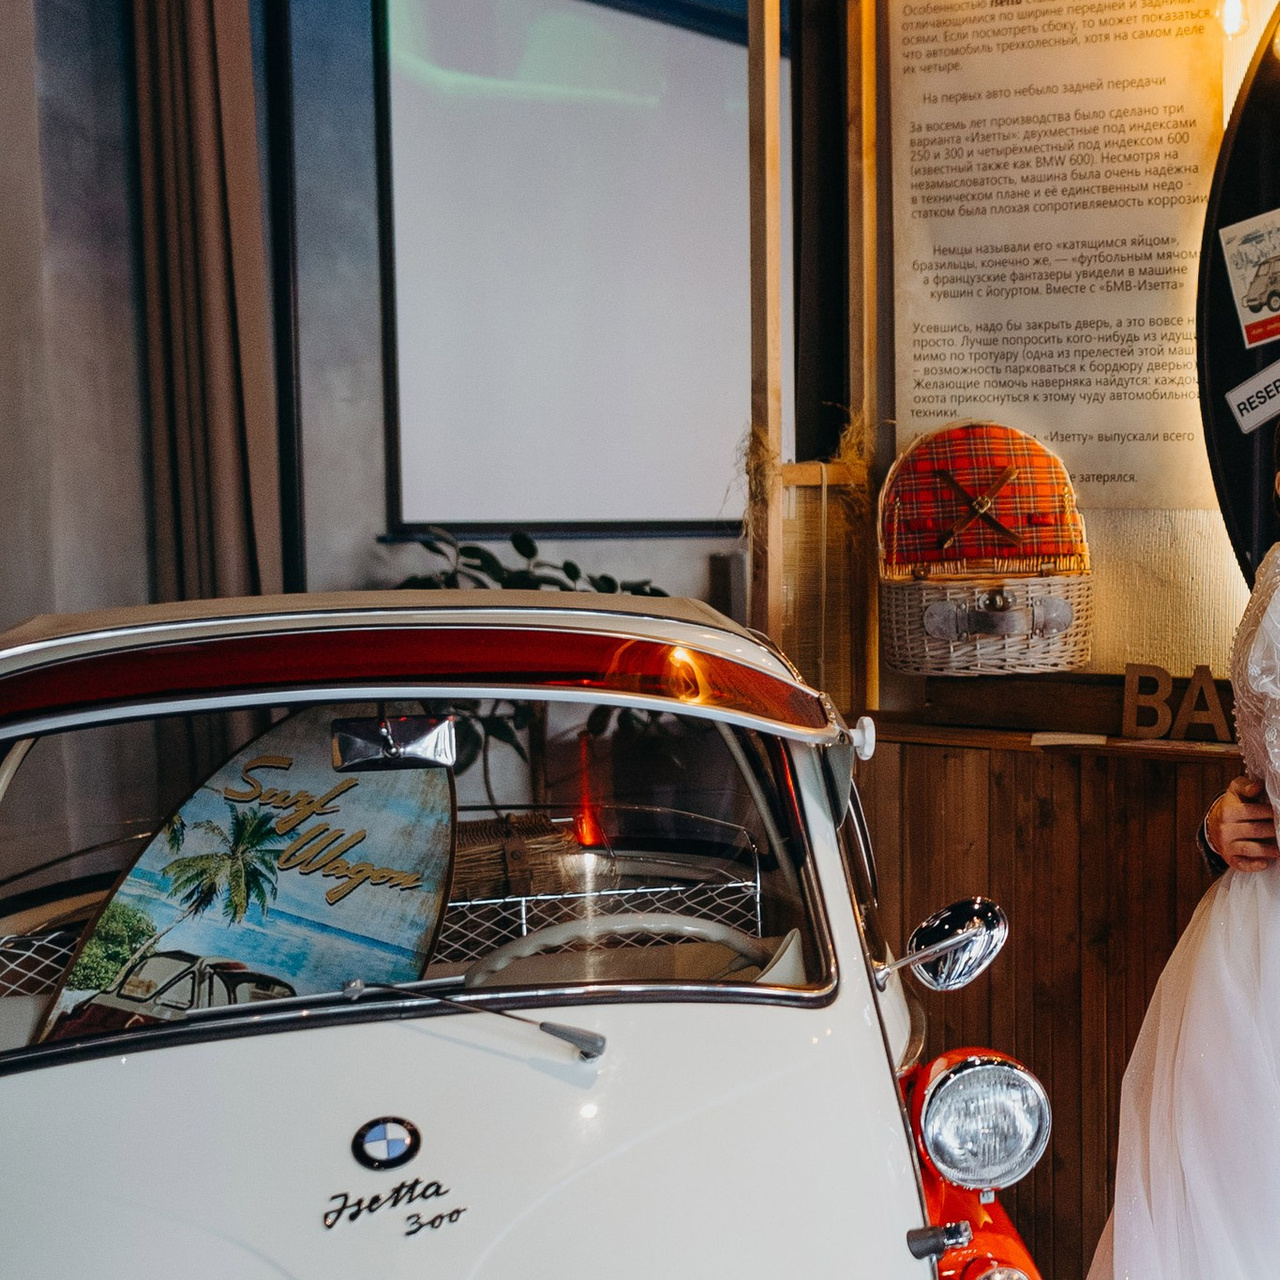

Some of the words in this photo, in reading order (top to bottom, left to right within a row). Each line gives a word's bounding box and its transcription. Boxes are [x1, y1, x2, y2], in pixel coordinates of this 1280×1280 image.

[1016, 6, 1064, 20] ширине
[942, 29, 969, 40] Если
[970, 24, 1039, 37] посмотреть
[1097, 14, 1137, 26] может
[902, 49, 922, 59] что
[924, 42, 993, 57] автомобиль
[1112, 31, 1128, 41] на
[1131, 28, 1172, 39] самом
[1175, 25, 1205, 37] деле
[921, 92, 938, 103] На
[940, 91, 982, 104] первых
[985, 89, 1011, 98] авто
[1062, 78, 1104, 93] задней
[1106, 76, 1166, 91] передачи
[909, 120, 922, 131] За
[924, 119, 966, 130] восемь
[969, 118, 986, 127] лет
[989, 112, 1071, 128] производства
[1073, 108, 1106, 120] было
[1108, 106, 1159, 119] сделано
[1162, 104, 1184, 116] три
[909, 134, 962, 147] варианта
[1022, 125, 1099, 140] двухместные
[1102, 123, 1126, 133] под
[1128, 118, 1197, 132] индексами
[909, 148, 930, 160] 250
[944, 146, 964, 157] 300
[1077, 140, 1100, 150] под
[1103, 136, 1163, 148] индексом
[1166, 131, 1190, 143] 600
[976, 160, 1009, 170] также
[1012, 159, 1031, 168] как
[1034, 154, 1066, 166] BMW
[1100, 151, 1160, 163] Несмотря
[1163, 150, 1179, 159] на
[1020, 172, 1067, 182] машина
[1069, 168, 1101, 180] была
[1103, 168, 1141, 178] очень
[920, 190, 993, 202] техническом
[995, 188, 1030, 198] плане
[1060, 182, 1149, 196] единственным
[1152, 180, 1183, 191] недо
[910, 208, 955, 218] статком
[957, 204, 987, 215] была
[989, 204, 1030, 214] плохая
[1032, 198, 1144, 213] сопротивляемость
[932, 244, 972, 256] Немцы
[975, 243, 1030, 253] называли
[1032, 242, 1052, 250] его
[1056, 238, 1127, 250] «катящимся
[1130, 234, 1179, 247] яйцом»,
[911, 259, 977, 273] бразильцы,
[980, 257, 1030, 267] конечно
[1071, 251, 1153, 266] «футбольным
[932, 273, 1006, 287] французские
[1009, 270, 1072, 284] фантазеры
[1075, 268, 1124, 281] увидели
[1138, 265, 1187, 275] машине
[929, 289, 974, 301] кувшин
[1045, 283, 1086, 294] Вместе
[1099, 279, 1184, 291] «БМВ-Изетта»
[912, 322, 972, 333] Усевшись,
[974, 322, 1003, 332] надо
[1005, 319, 1022, 330] бы
[1025, 320, 1072, 331] закрыть
[1074, 318, 1112, 330] дверь,
[1126, 317, 1145, 326] это
[1148, 316, 1183, 325] вовсе
[960, 335, 999, 349] Лучше
[1001, 335, 1063, 347] попросить
[1065, 331, 1140, 345] кого-нибудь
[912, 353, 946, 361] мимо
[968, 351, 1018, 363] тротуару
[1021, 348, 1054, 361] (одна
[1073, 344, 1134, 360] прелестей
[1137, 343, 1165, 355] этой
[922, 365, 1002, 375] возможность
[1004, 363, 1076, 376] парковаться
[1088, 360, 1143, 374] бордюру
[912, 378, 980, 390] Желающие
[983, 379, 1028, 388] помочь
[1030, 377, 1092, 389] наверняка
[912, 395, 946, 404] охота
[949, 394, 1030, 406] прикоснуться
[1042, 393, 1076, 404] этому
[1078, 392, 1105, 403] чуду
[1109, 388, 1200, 400] автомобильно
[910, 408, 960, 416] техники.
[1042, 430, 1094, 443] «Изетту»
[1096, 431, 1159, 443] выпускали
[1161, 431, 1195, 439] всего
[1078, 473, 1138, 485] затерялся.
[1121, 662, 1232, 742] BA
[223, 755, 359, 834] Surf
[277, 821, 423, 906] Wagon
[323, 1176, 451, 1230] Isetta
[404, 1205, 469, 1237] 300
